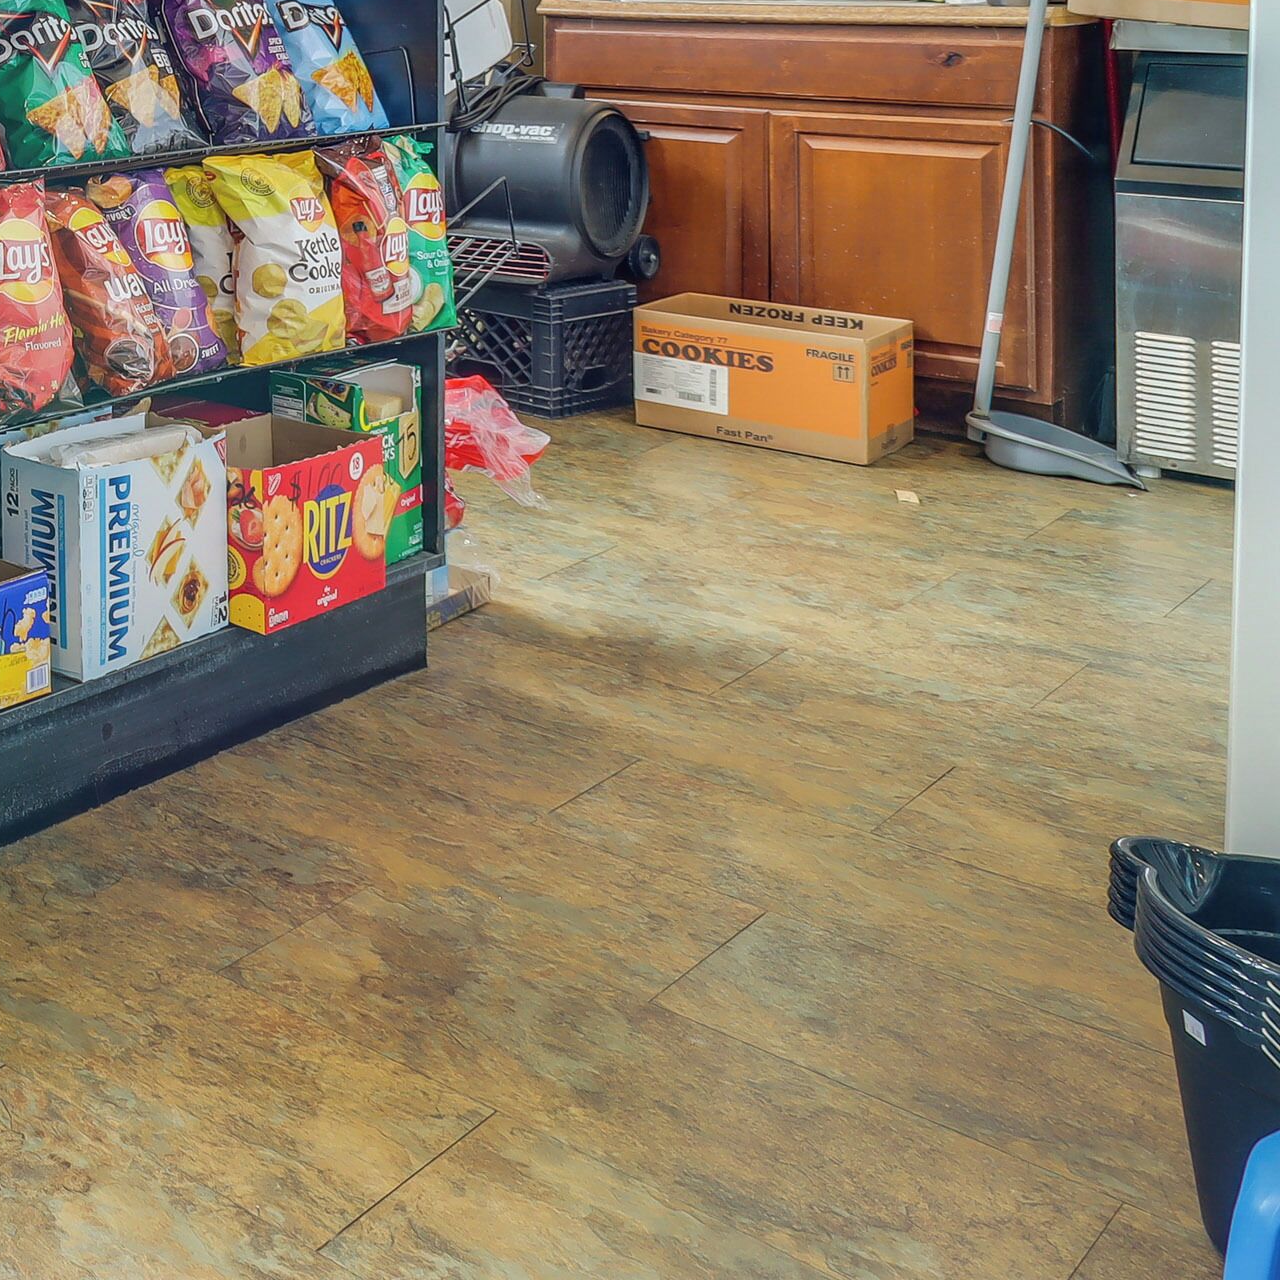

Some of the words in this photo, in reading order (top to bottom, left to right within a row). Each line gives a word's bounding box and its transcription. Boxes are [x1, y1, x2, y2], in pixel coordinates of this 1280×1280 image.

[293, 197, 323, 222] Lay's
[295, 233, 339, 264] Kettle
[729, 303, 805, 323] FROZEN
[811, 315, 863, 330] KEEP
[641, 326, 672, 337] Bakery
[674, 330, 714, 343] Category
[642, 338, 774, 373] COOKIES
[806, 348, 855, 363] FRAGILE
[716, 426, 742, 439] Fast
[6, 494, 20, 517] 12
[303, 491, 352, 564] RITZ
[108, 474, 131, 662] PREMIUM
